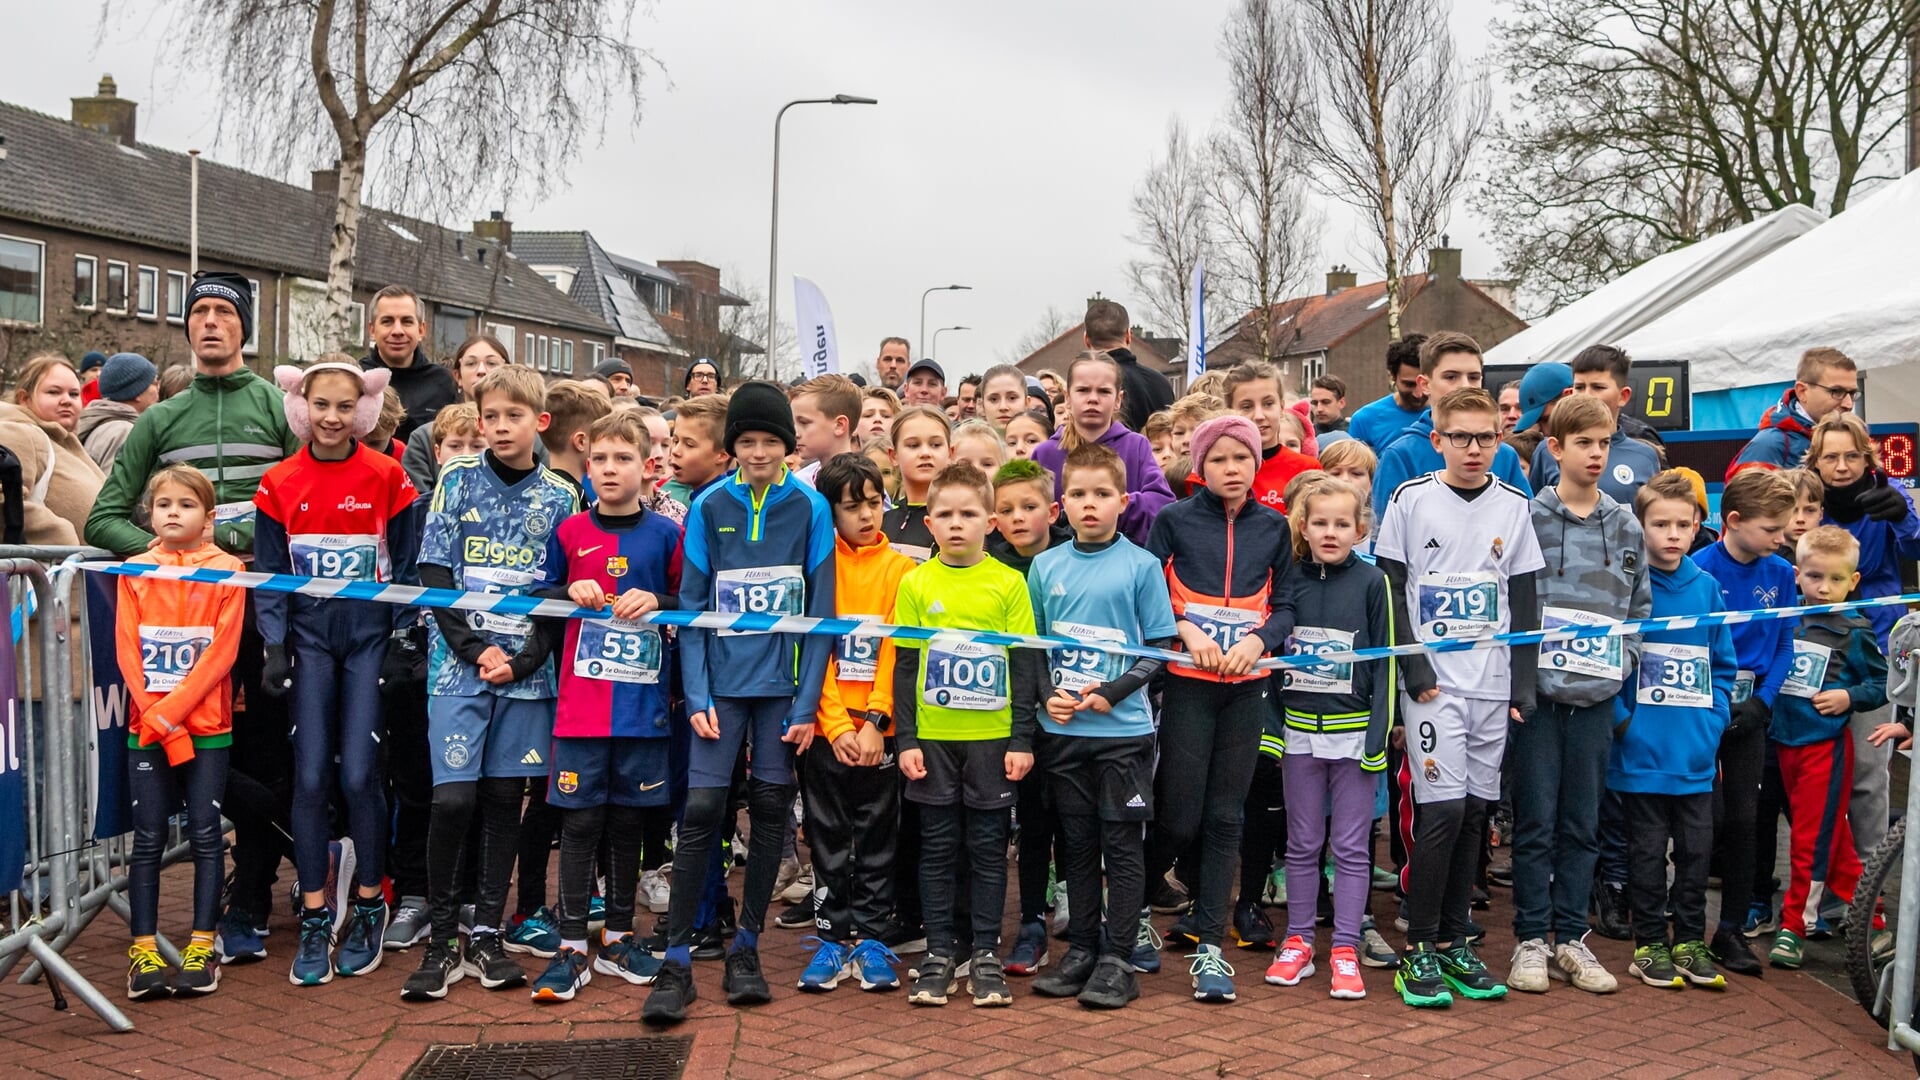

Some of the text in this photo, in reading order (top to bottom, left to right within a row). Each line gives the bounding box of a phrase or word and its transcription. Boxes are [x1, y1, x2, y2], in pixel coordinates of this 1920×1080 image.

[1645, 377, 1674, 417] 0
[1884, 435, 1912, 476] 8
[306, 551, 361, 577] 192
[464, 536, 534, 567] Ziggo
[733, 585, 786, 613] 187
[1435, 589, 1486, 616] 219
[142, 643, 196, 670] 210
[602, 632, 641, 660] 53
[842, 634, 872, 659] 15
[1061, 649, 1100, 670] 99
[938, 658, 996, 687] 100
[1662, 660, 1696, 686] 38
[1788, 655, 1812, 677] 9
[961, 695, 997, 704] Onderlingen
[1419, 721, 1437, 754] 9
